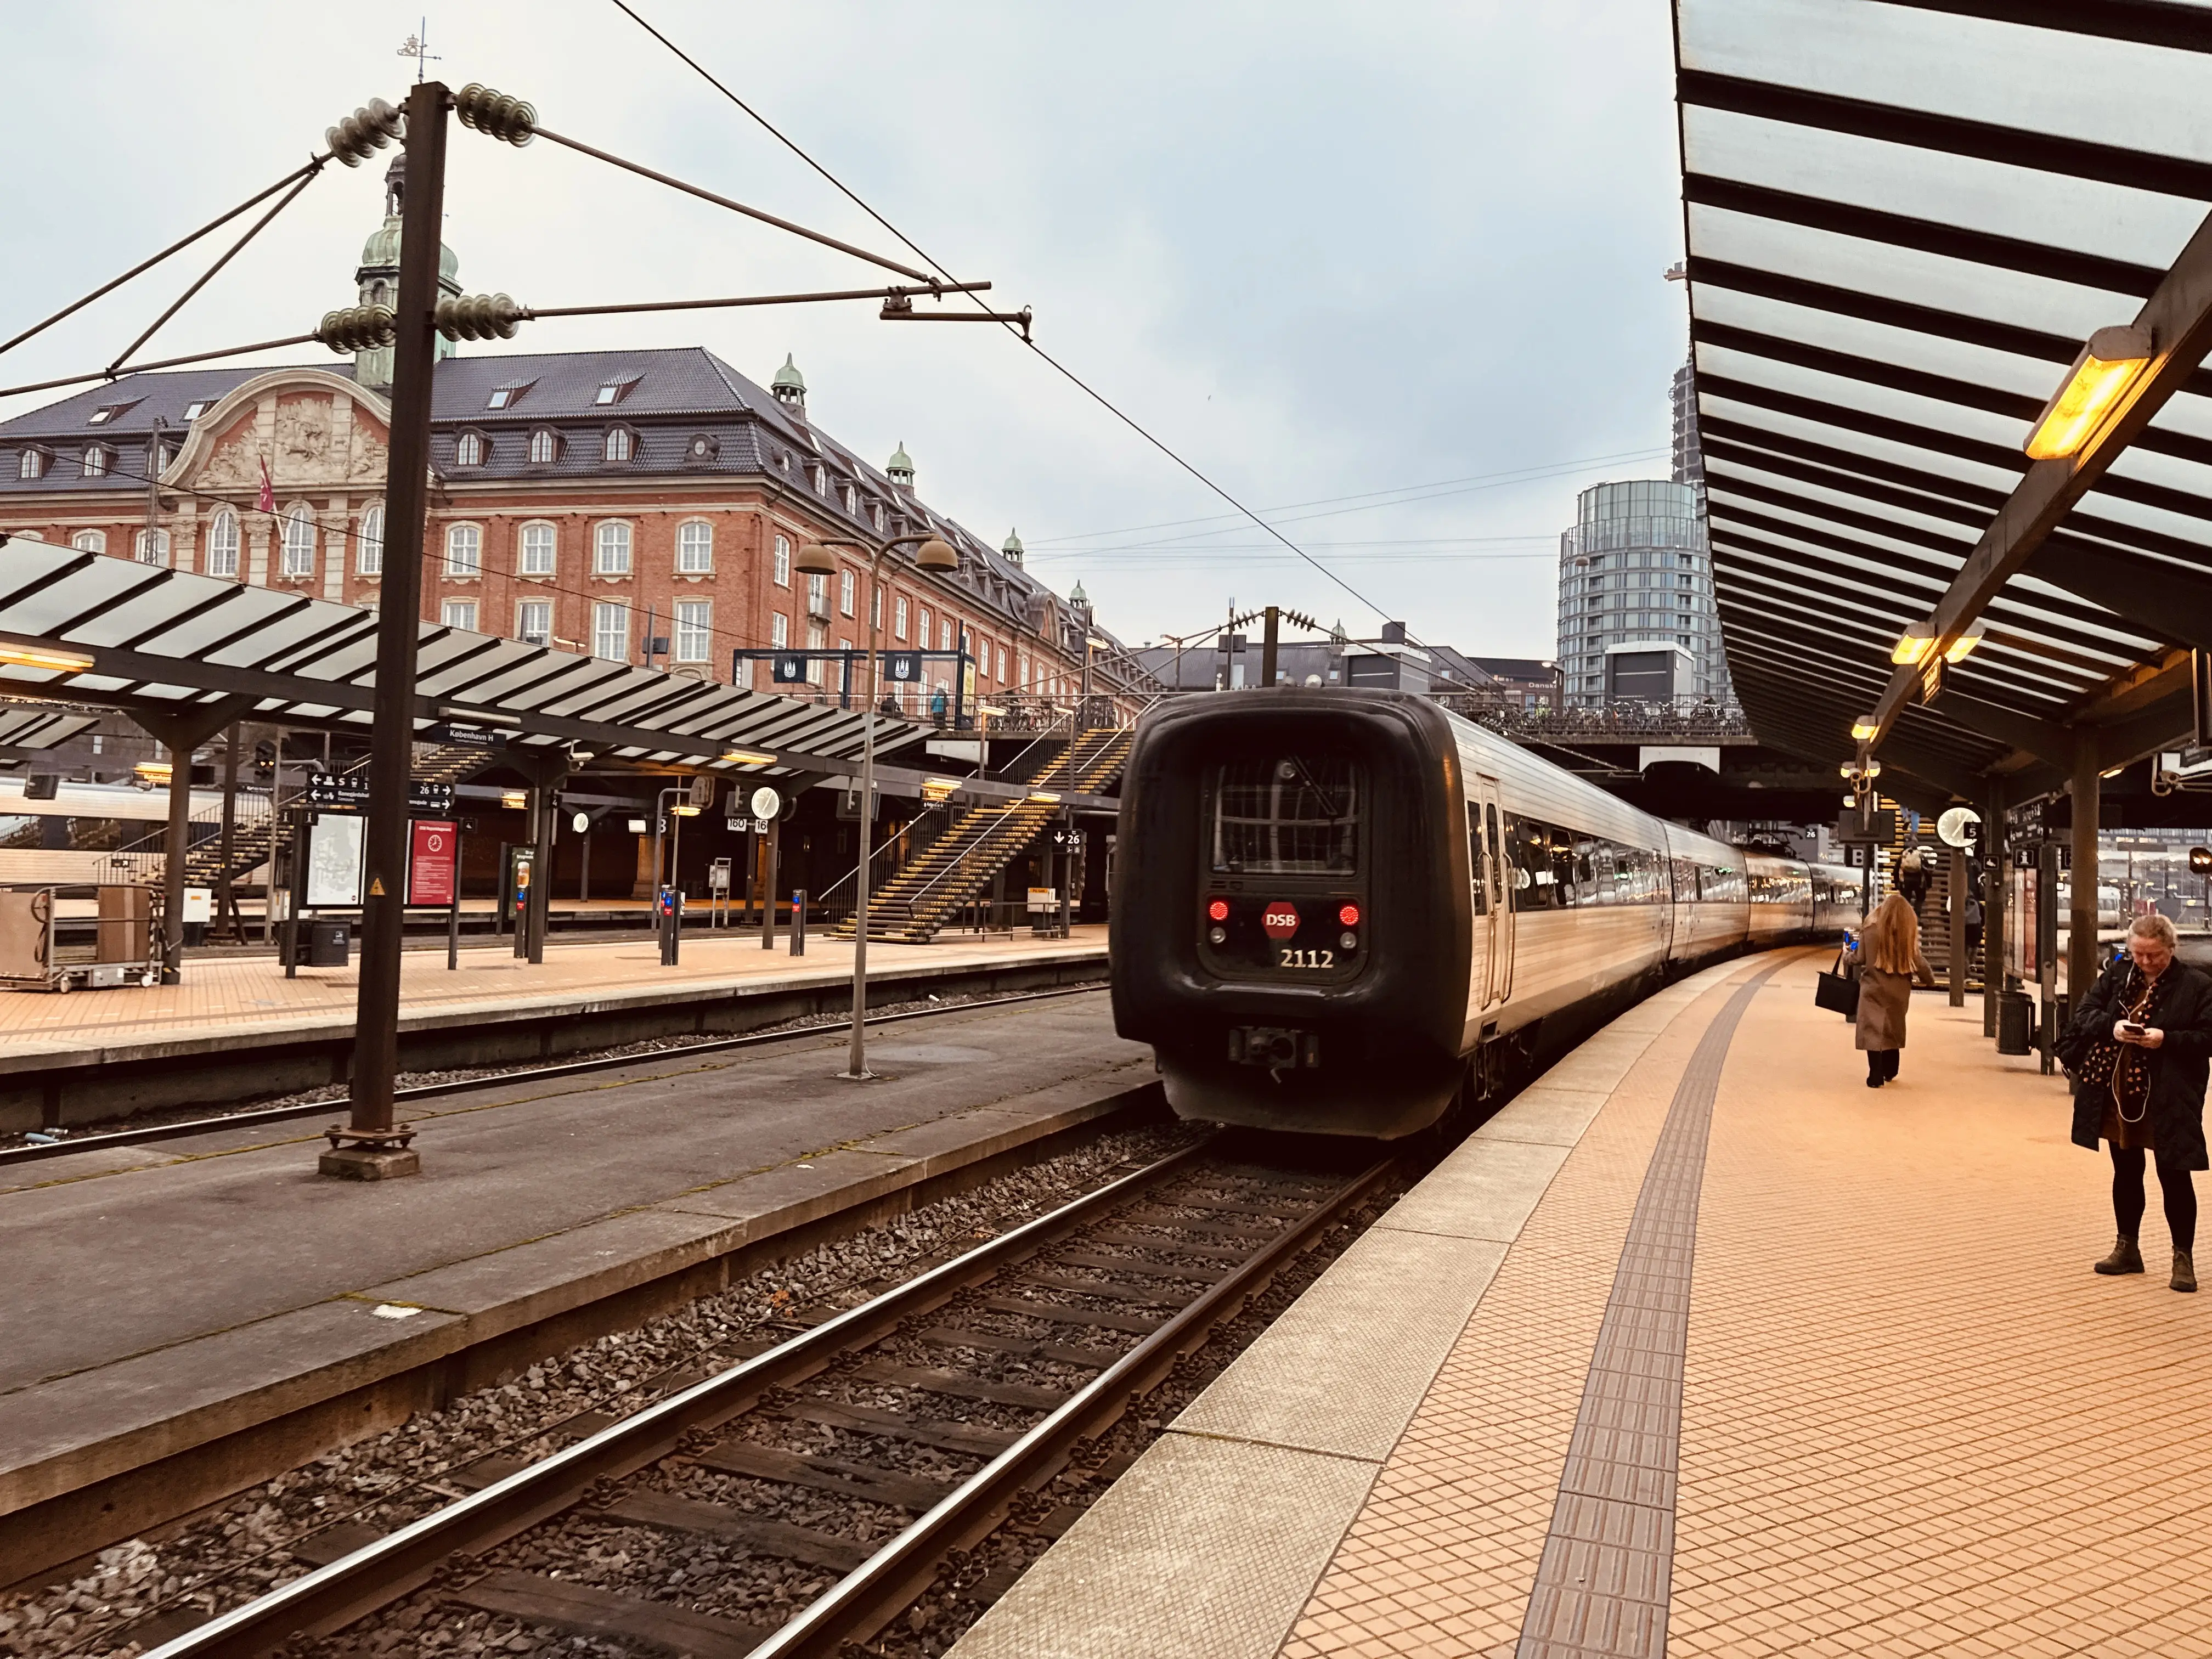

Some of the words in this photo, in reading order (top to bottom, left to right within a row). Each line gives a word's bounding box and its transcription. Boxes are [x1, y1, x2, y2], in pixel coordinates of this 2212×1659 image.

[450, 730, 487, 741] København
[420, 786, 430, 794] 26
[729, 818, 744, 828] 160
[757, 820, 767, 830] 16
[1970, 827, 1977, 837] 5
[1068, 834, 1080, 844] 26
[1852, 849, 1864, 866] B
[1266, 914, 1296, 927] DSB
[1280, 949, 1334, 968] 2112
